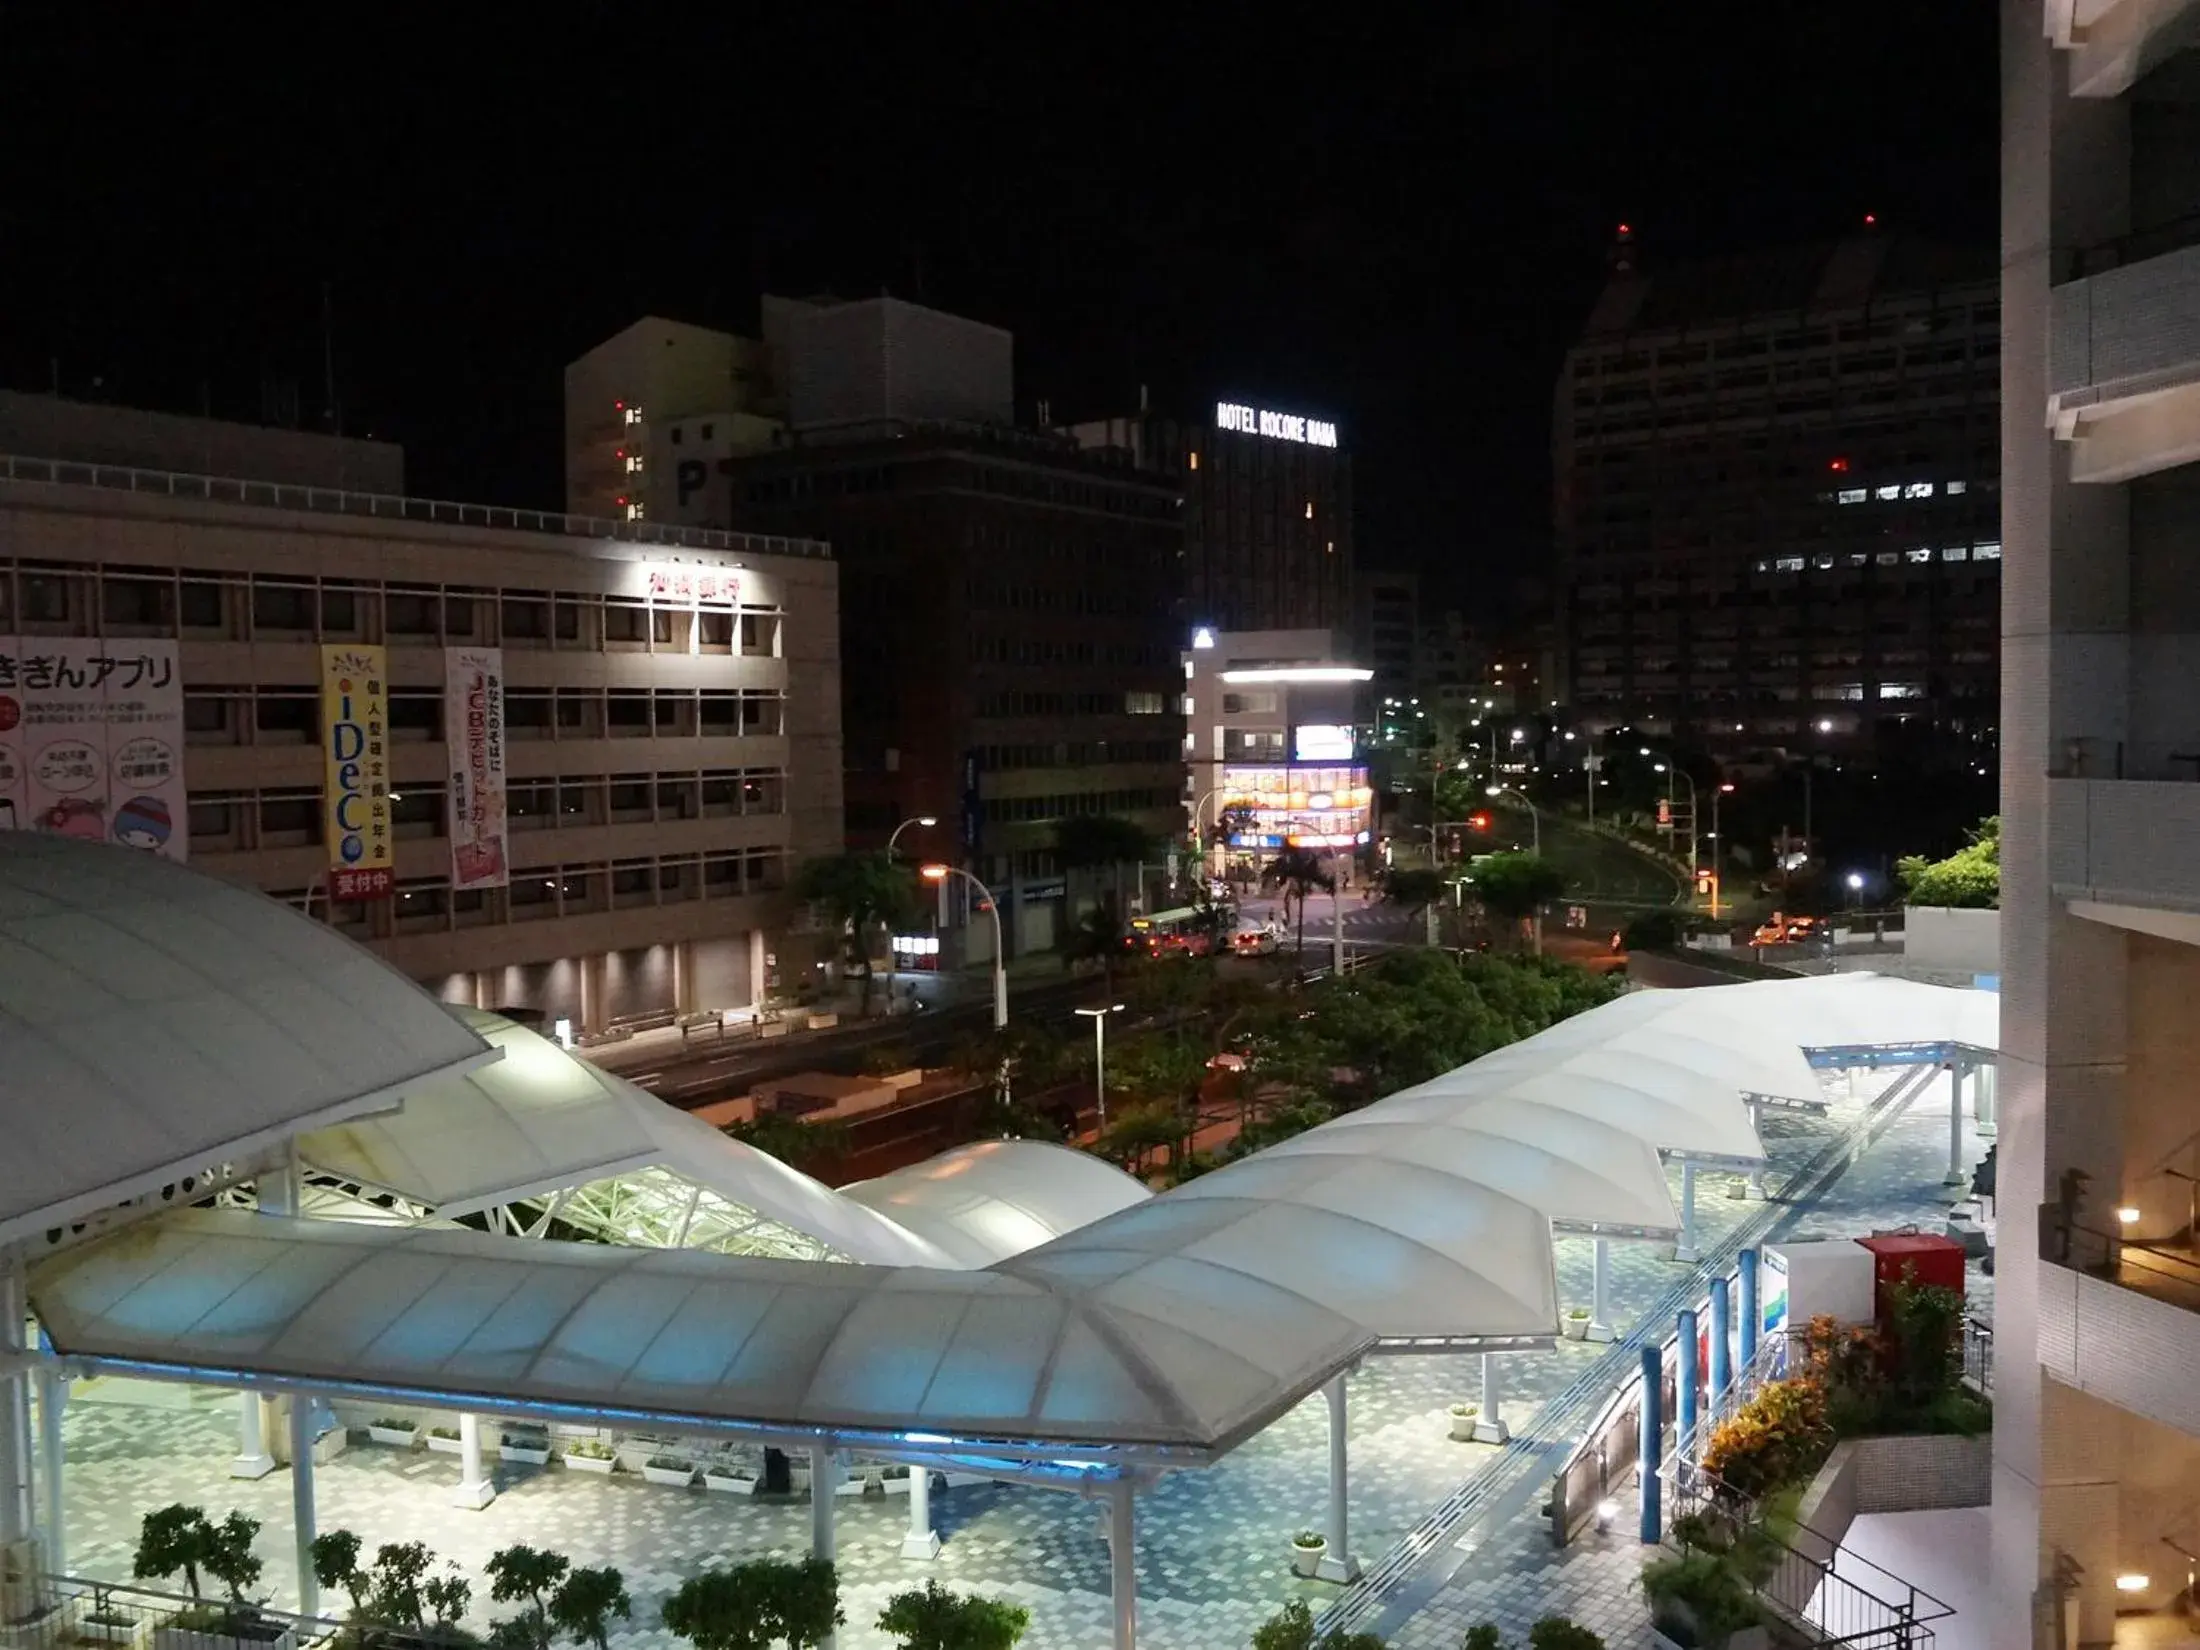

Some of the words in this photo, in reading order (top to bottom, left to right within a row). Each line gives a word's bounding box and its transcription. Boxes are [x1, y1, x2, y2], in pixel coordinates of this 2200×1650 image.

[1217, 401, 1258, 434] HOTEL
[1260, 410, 1306, 443] ROCORE
[1307, 418, 1338, 448] NAHA
[678, 460, 707, 507] P
[332, 678, 365, 863] iDeCo
[336, 871, 389, 895] 受付中
